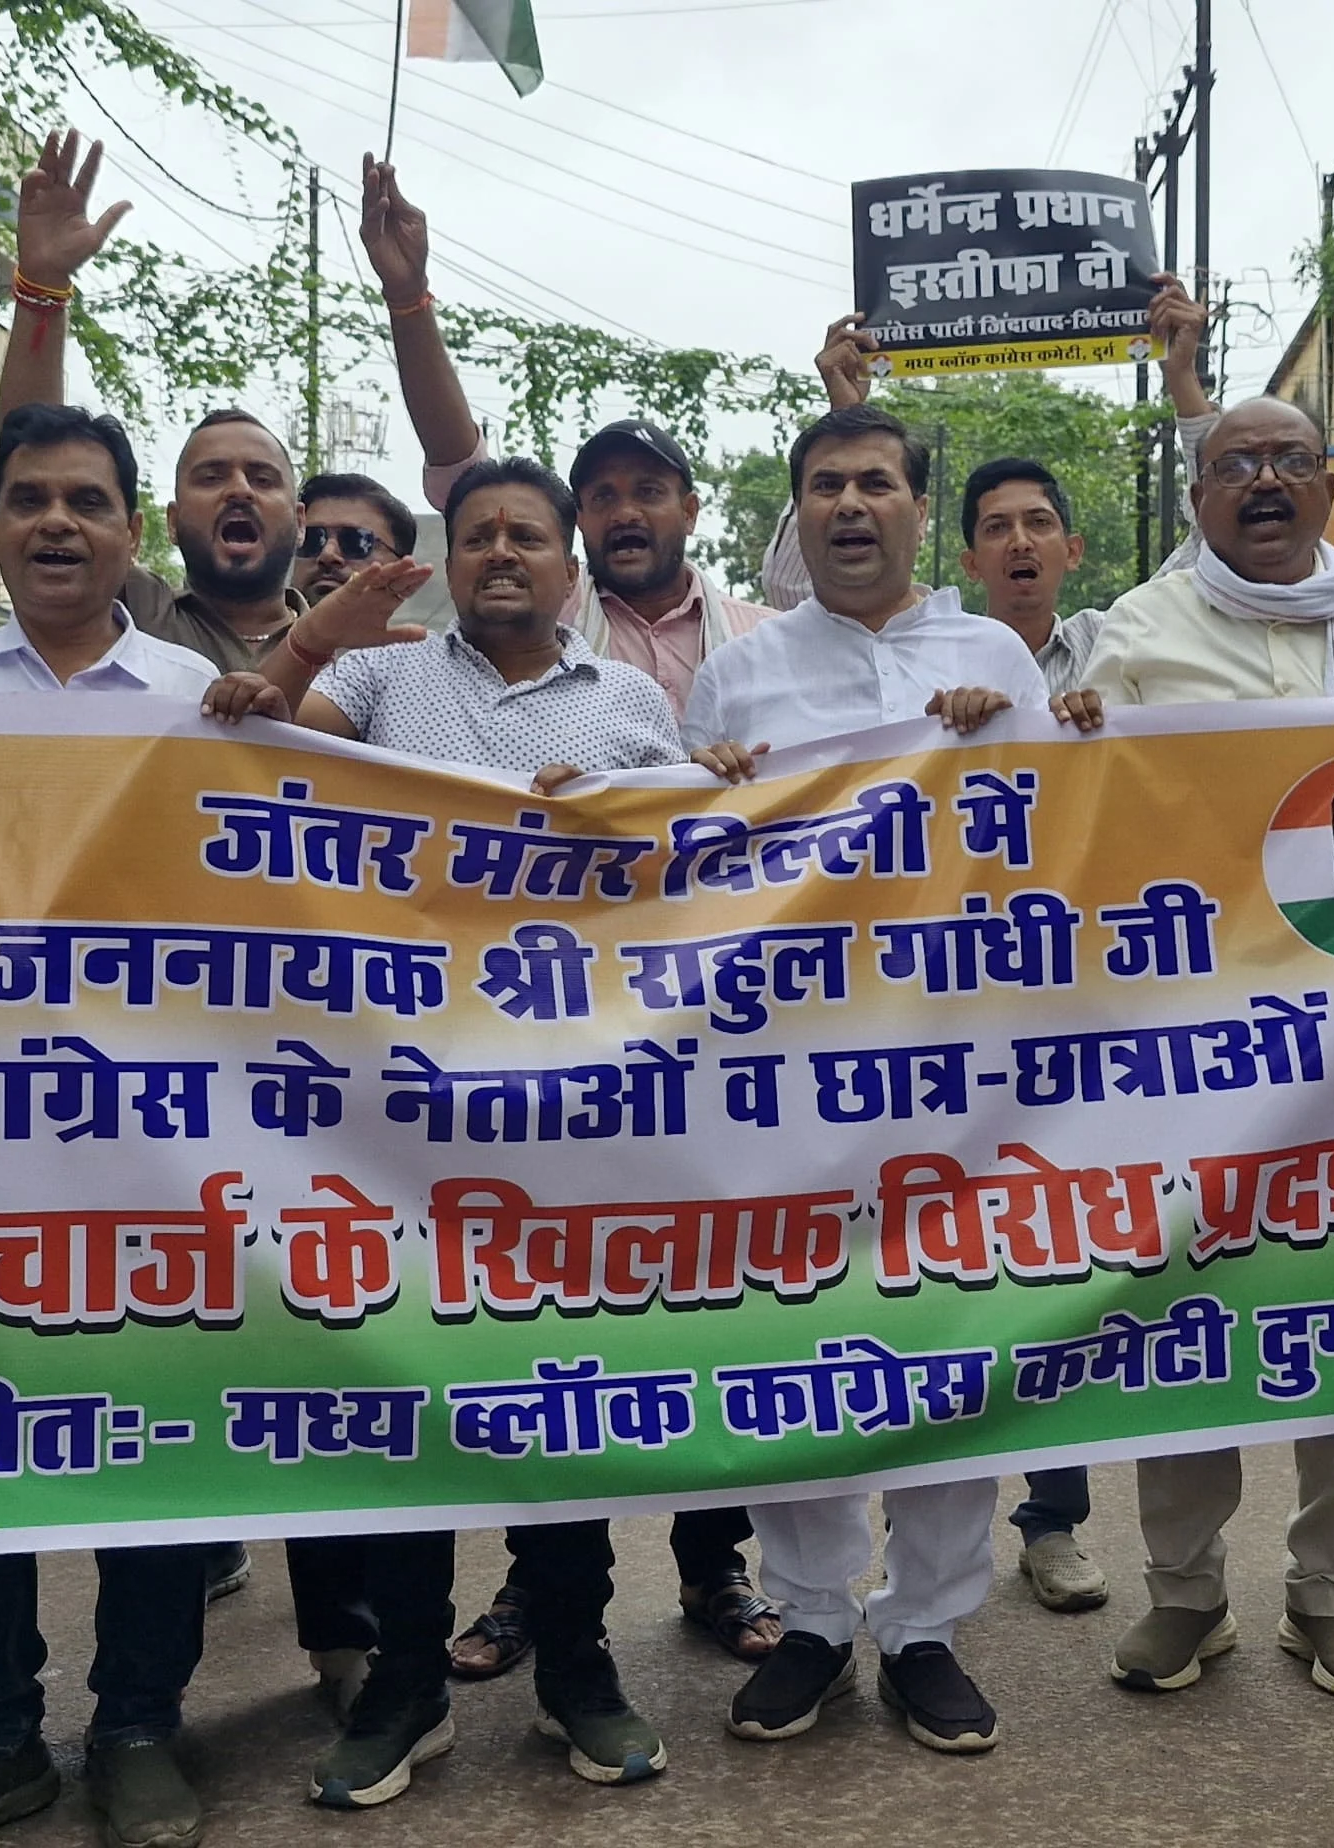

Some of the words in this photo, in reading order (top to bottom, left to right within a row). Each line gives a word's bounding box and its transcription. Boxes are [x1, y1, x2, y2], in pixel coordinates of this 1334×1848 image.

[869, 183, 1002, 238] धर्मेन्द्र
[1014, 190, 1136, 231] प्रधान
[886, 248, 1063, 310] इस्तीफा
[1075, 240, 1130, 290] दो
[928, 315, 975, 339] पार्टी
[978, 306, 1150, 335] जिंदाबाद-जिंदाबा
[904, 356, 935, 371] मध्य
[938, 351, 981, 369] ब्लॉक
[985, 346, 1033, 365] कांग्रेस
[1092, 341, 1116, 362] दुर्ग
[203, 780, 430, 892] जंतर
[451, 811, 654, 898] मंतर
[664, 782, 933, 898] दिल्ली
[957, 772, 1036, 866] में
[477, 923, 593, 1020] श्री
[620, 926, 853, 1035] राहुल
[873, 892, 1080, 993] गांधी
[1101, 882, 1217, 977] जी
[246, 1040, 351, 1137] के
[382, 1038, 697, 1143] नेताओं
[720, 1055, 785, 1128] व
[809, 991, 1328, 1124] छात्र-छात्राओं
[279, 1174, 395, 1308] के
[429, 1178, 854, 1304] खिलाफ
[877, 1142, 1164, 1278] विरोध
[226, 1389, 425, 1459] मध्य
[449, 1360, 692, 1455] ब्लॉक
[717, 1338, 993, 1436] कांग्रेस
[1015, 1297, 1234, 1400] कमेटी
